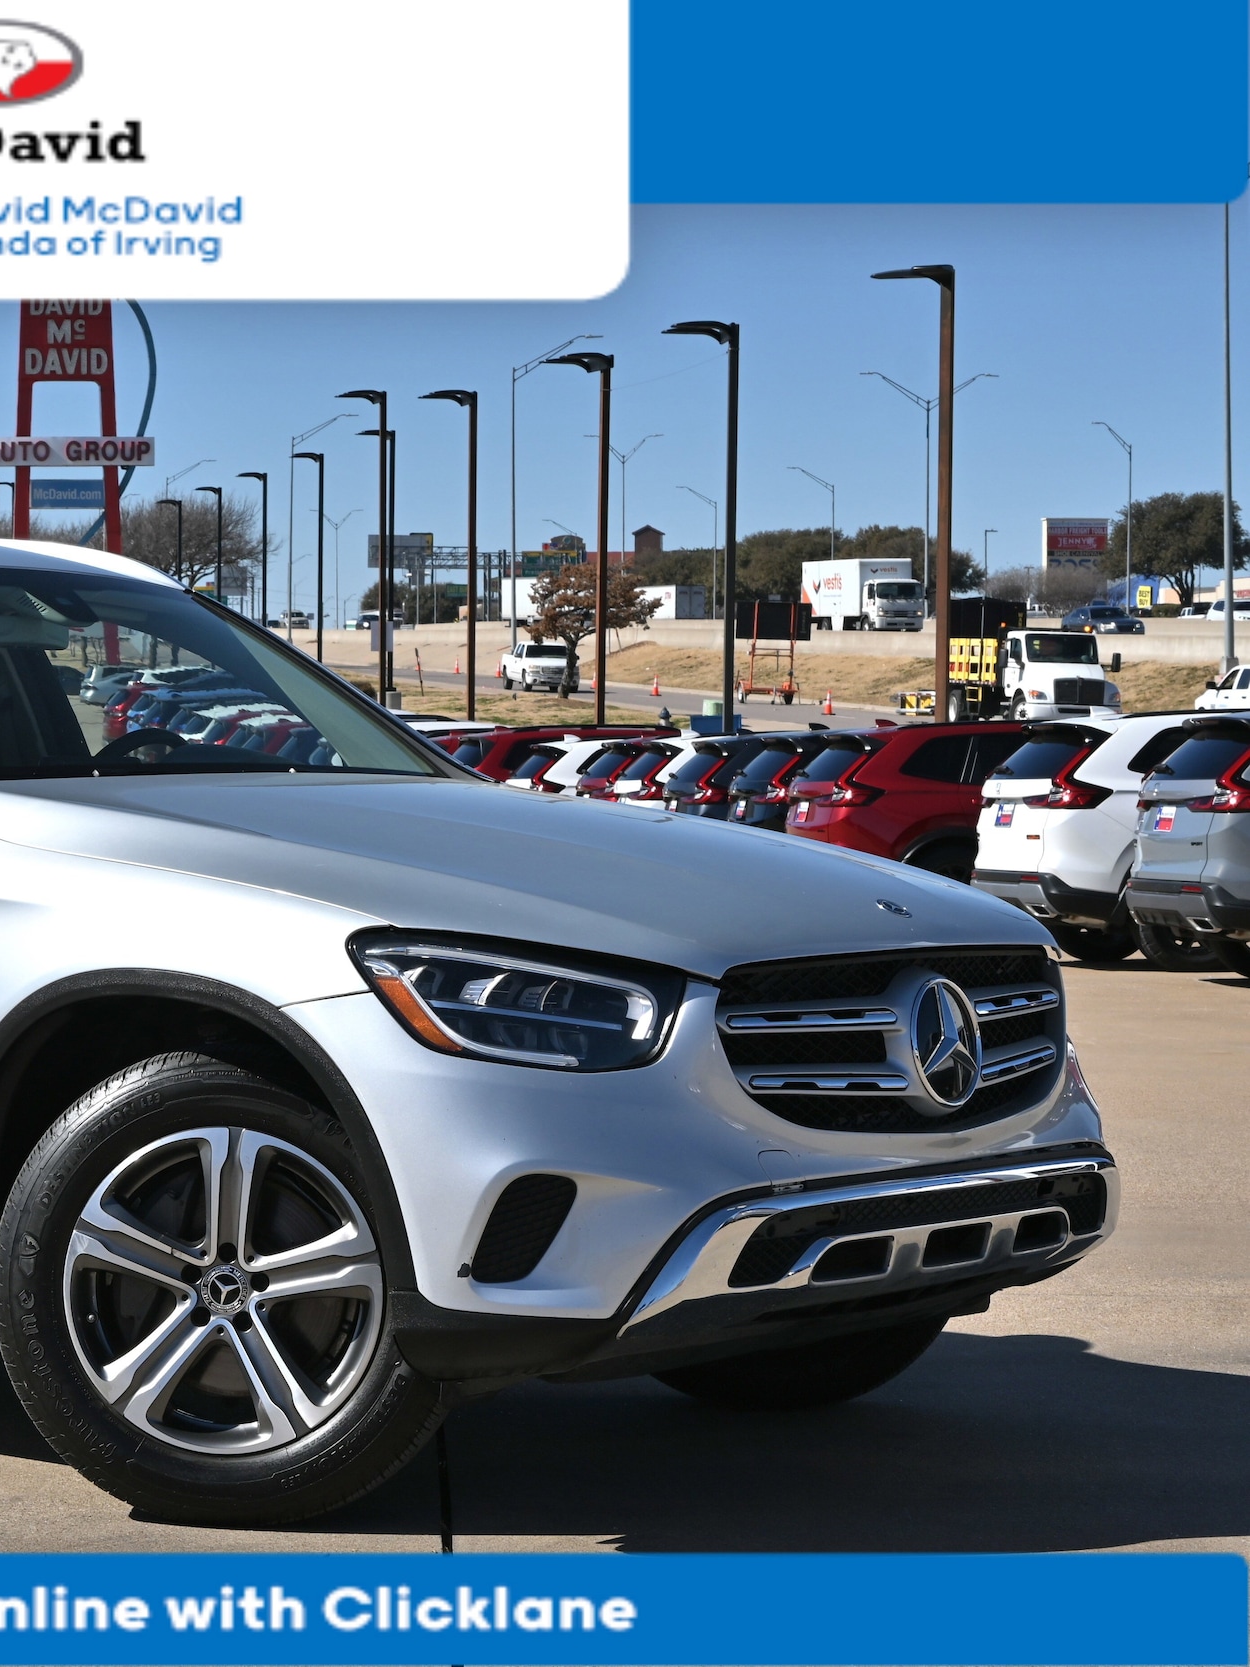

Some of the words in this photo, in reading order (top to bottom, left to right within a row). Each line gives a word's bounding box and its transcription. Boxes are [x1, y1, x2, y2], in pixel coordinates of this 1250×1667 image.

[29, 299, 103, 316] DAVID
[24, 348, 108, 375] DAVID
[65, 440, 151, 462] GROUP
[33, 488, 101, 500] McDavid.com
[823, 573, 843, 591] vestis
[1138, 590, 1150, 598] BEST
